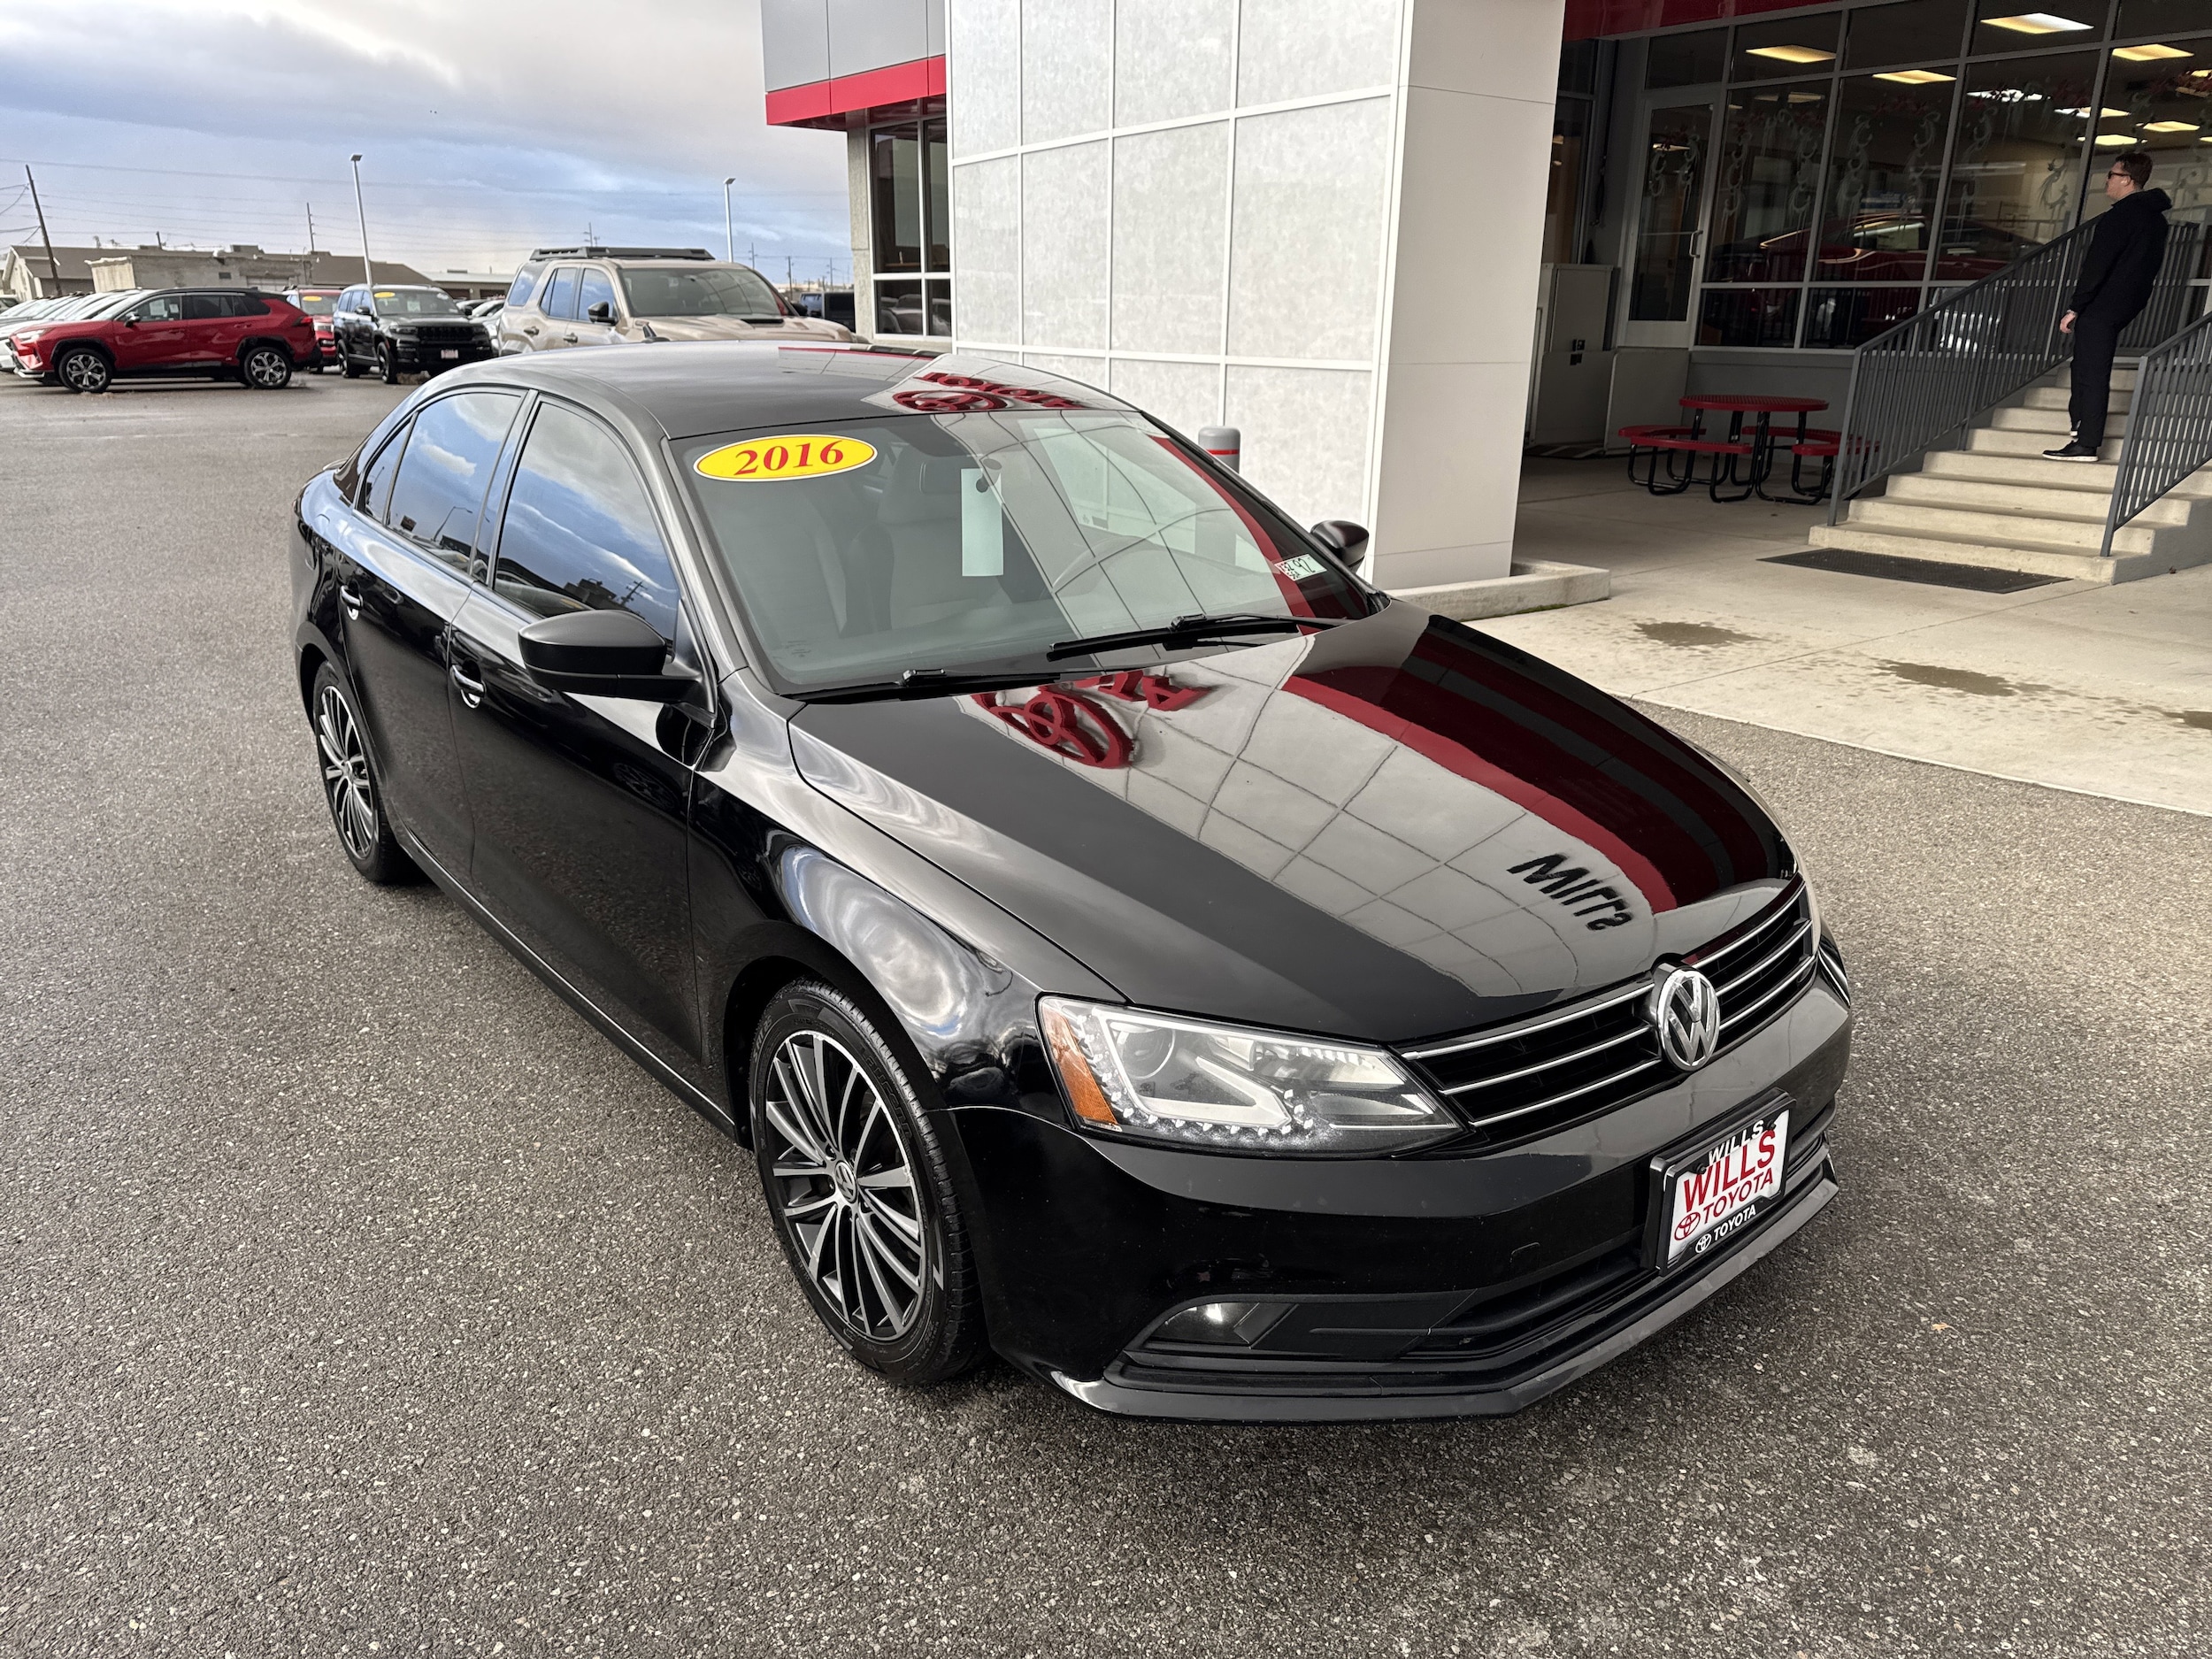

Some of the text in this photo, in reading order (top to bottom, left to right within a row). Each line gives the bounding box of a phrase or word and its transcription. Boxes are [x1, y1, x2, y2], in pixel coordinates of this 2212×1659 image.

[733, 440, 844, 476] 2016
[1708, 1119, 1764, 1164] WILLS
[1683, 1129, 1776, 1212] WILLS
[1703, 1167, 1773, 1224] TOYOTA
[1714, 1204, 1756, 1240] TOYOTA
